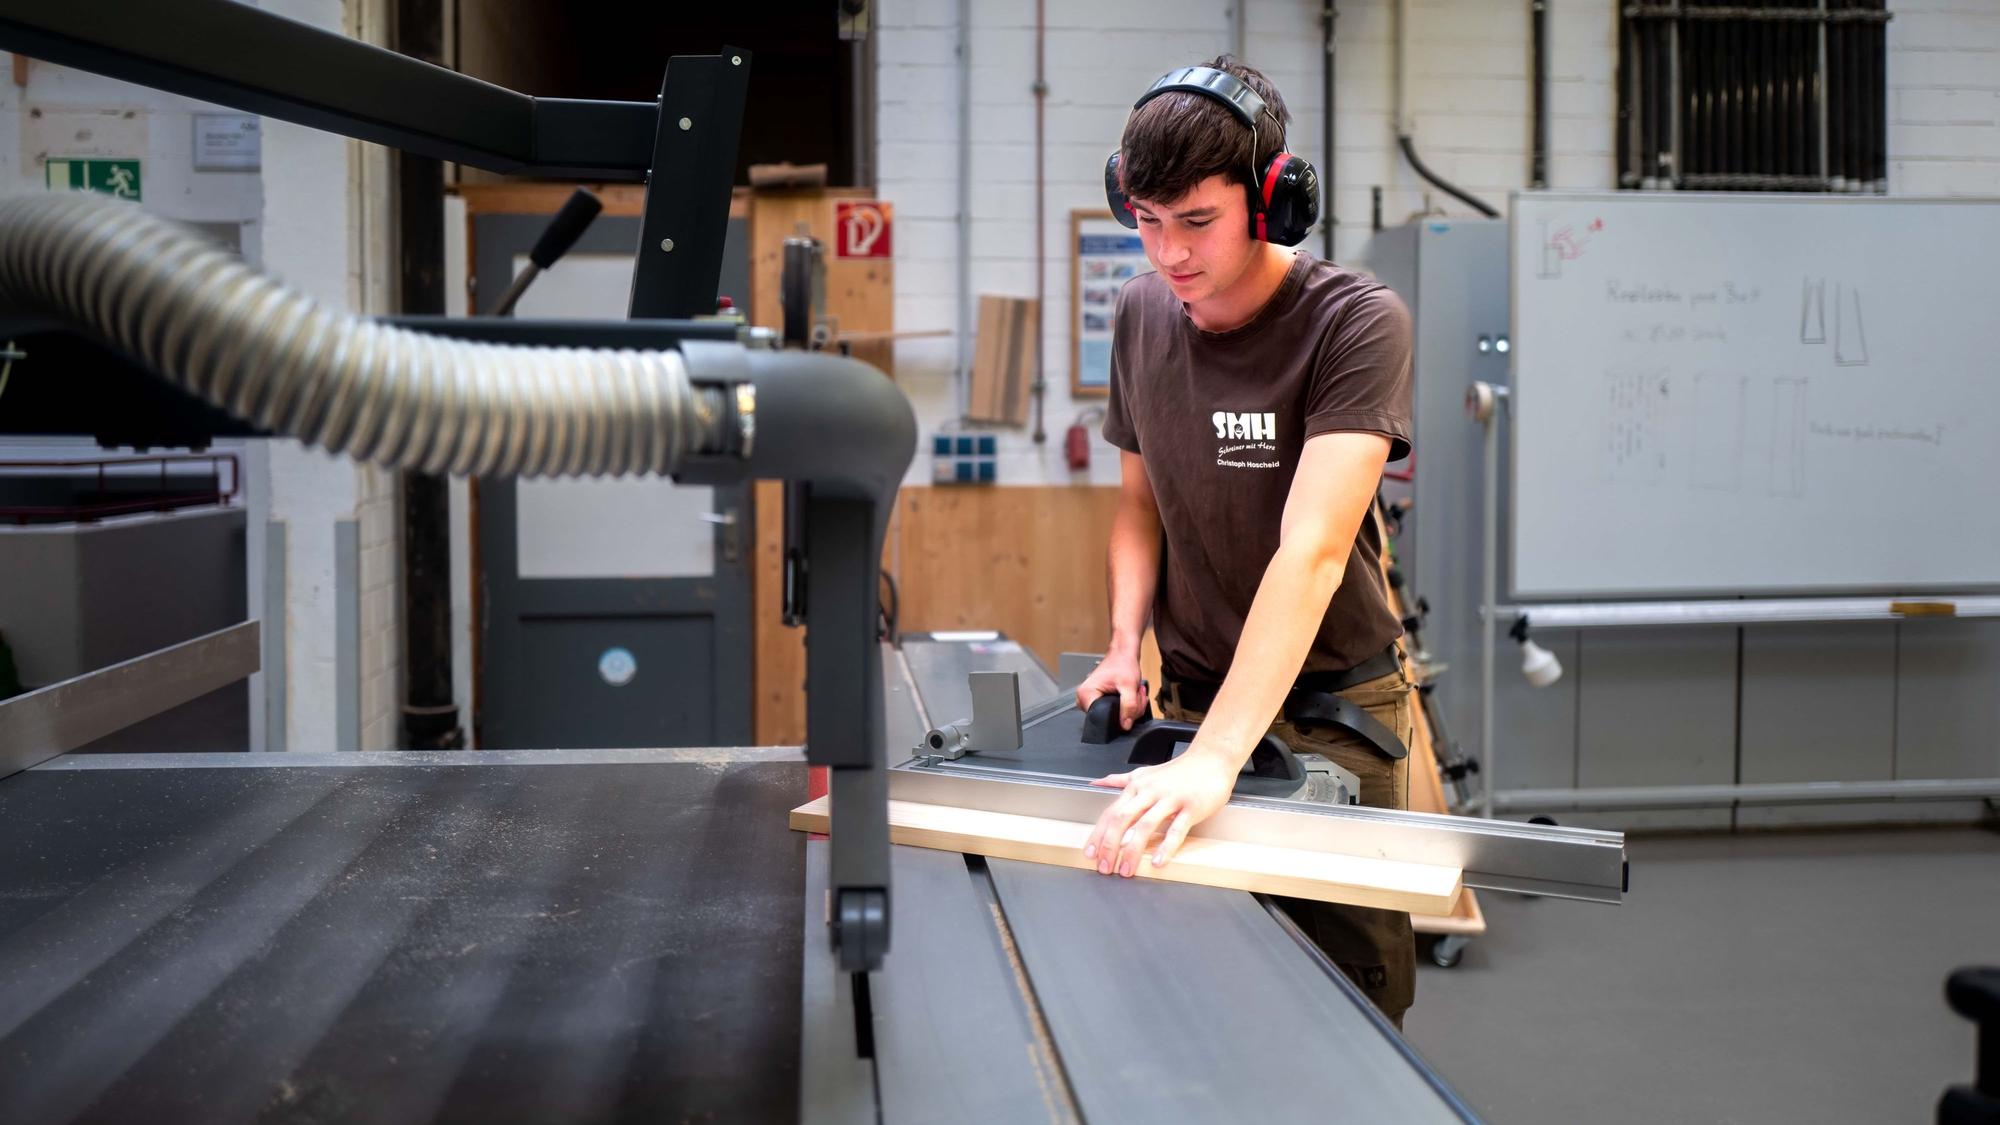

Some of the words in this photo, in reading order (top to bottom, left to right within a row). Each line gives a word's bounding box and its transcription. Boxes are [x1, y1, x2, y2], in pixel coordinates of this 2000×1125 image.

[1212, 411, 1276, 440] SMH
[1218, 445, 1245, 458] Schreiner
[1257, 442, 1276, 451] Herz
[1217, 459, 1246, 469] Christoph
